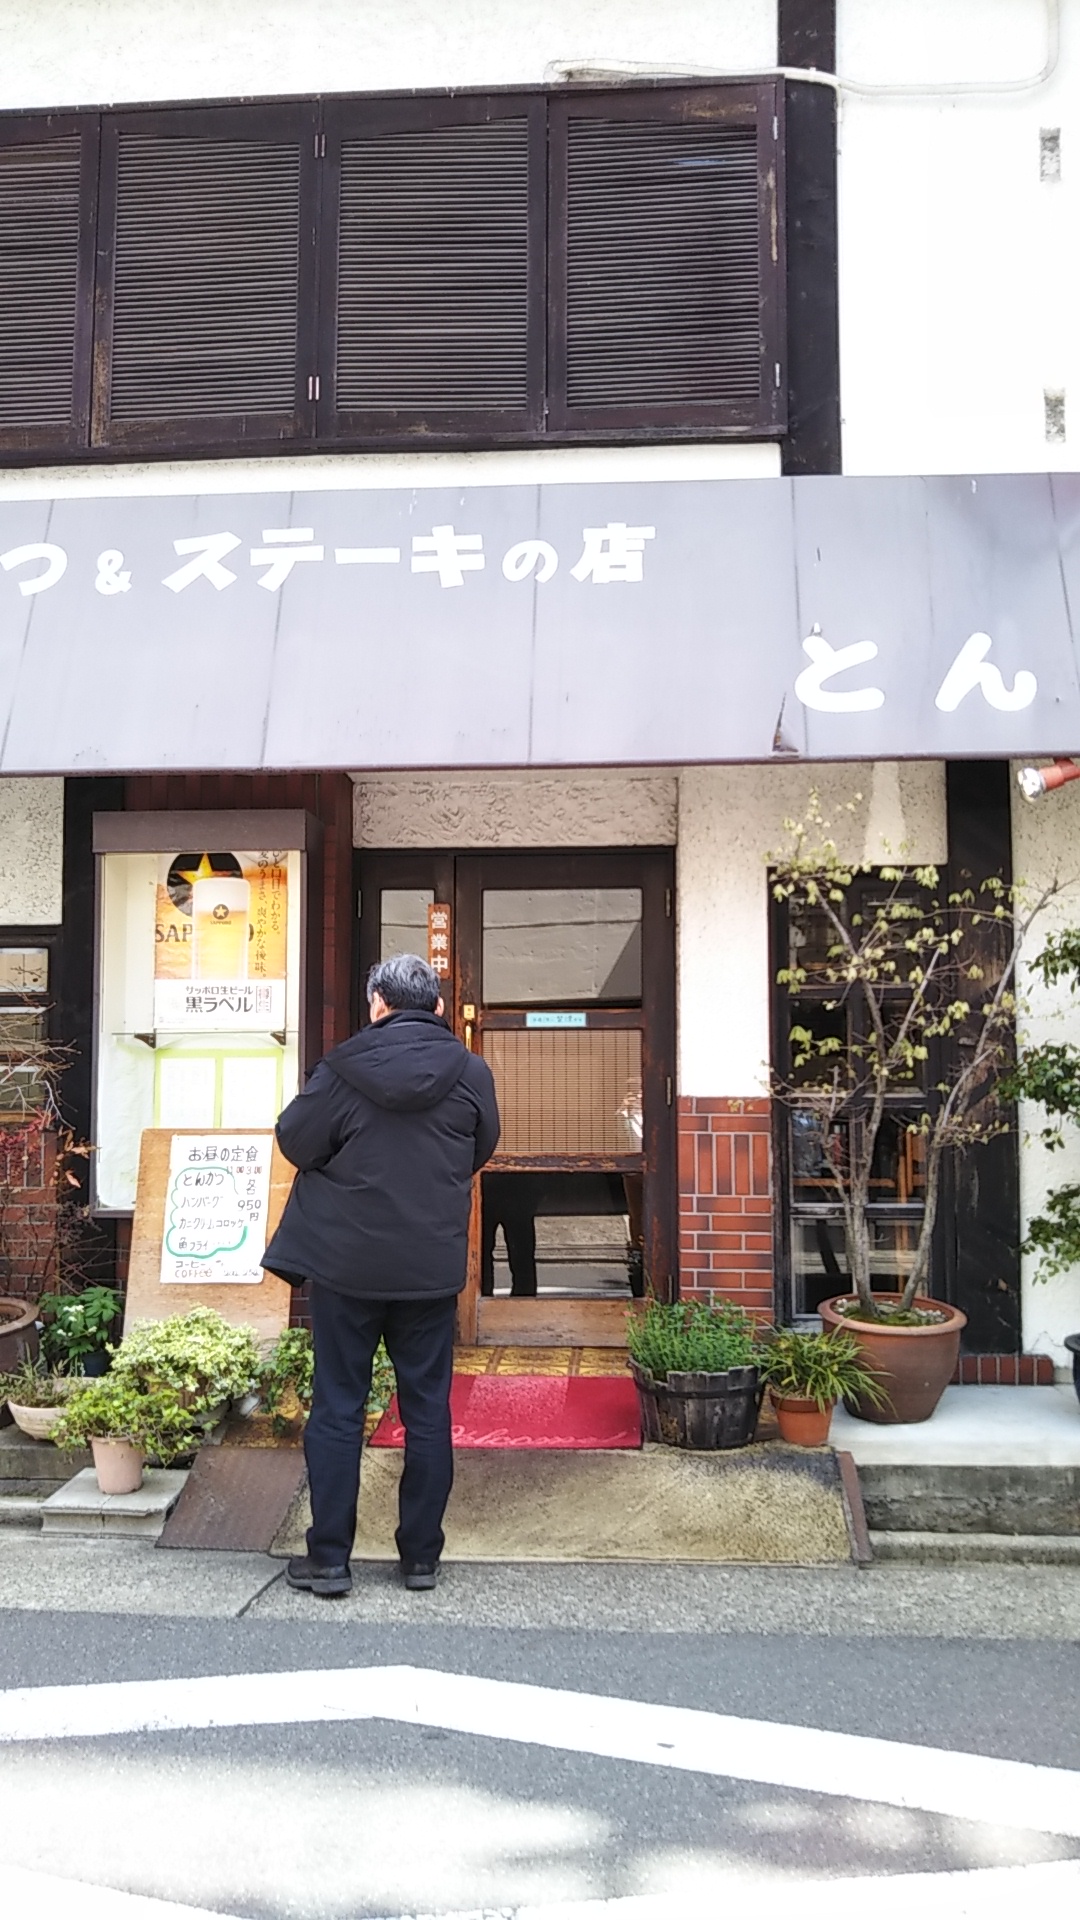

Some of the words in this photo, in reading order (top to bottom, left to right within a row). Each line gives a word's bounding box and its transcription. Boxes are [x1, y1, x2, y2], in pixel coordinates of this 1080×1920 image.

[795, 632, 1038, 713] とん
[430, 911, 449, 973] 営業中
[185, 985, 254, 995] サッポロ生ビール
[185, 996, 254, 1013] 黒ラベル
[188, 1145, 259, 1162] お昼の定食
[183, 1172, 224, 1187] とんかつ
[181, 1196, 224, 1209] ハンバーグ
[237, 1199, 262, 1211] 950
[175, 1260, 206, 1268] コーヒー
